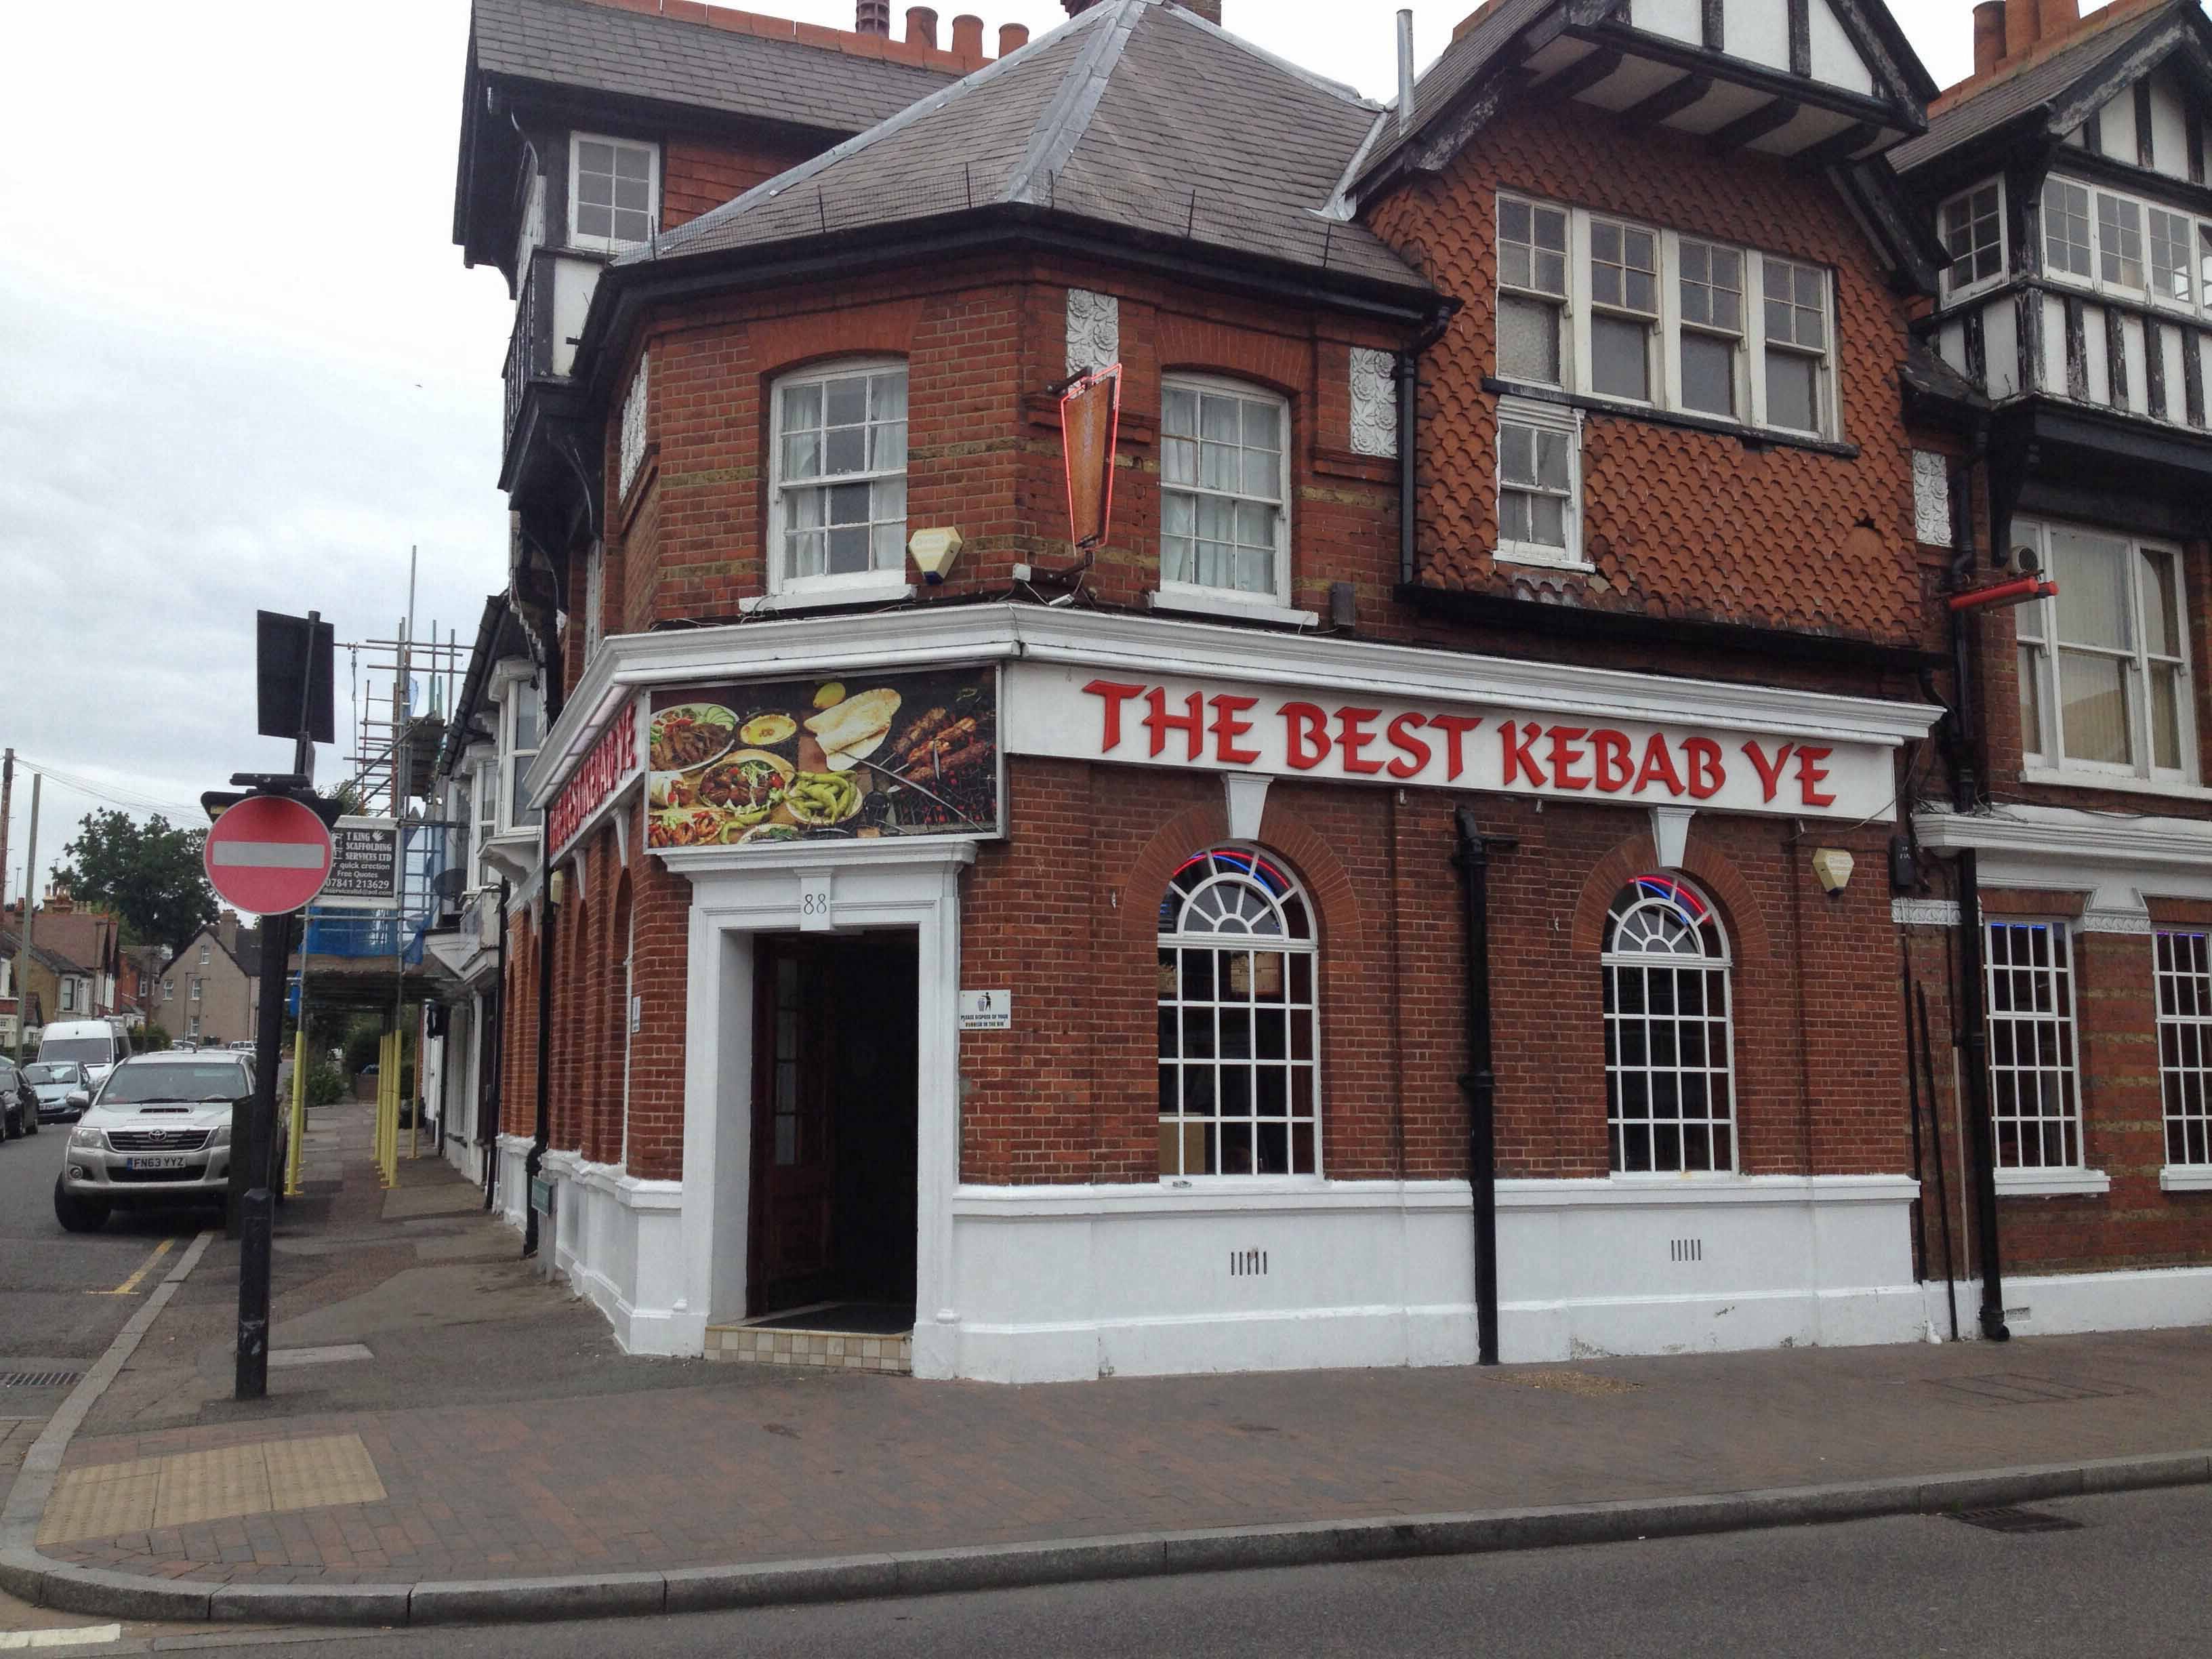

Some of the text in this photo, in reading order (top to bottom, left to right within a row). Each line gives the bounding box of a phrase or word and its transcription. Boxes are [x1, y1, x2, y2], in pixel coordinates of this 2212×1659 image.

[1082, 679, 1837, 807] THE BEST KEBAB YE
[353, 832, 370, 841] KING
[346, 842, 392, 852] SCAFFOLDING
[346, 851, 392, 862] SERVICES LTD
[354, 871, 378, 879] Quotes
[326, 878, 389, 889] 07841 213629
[804, 893, 827, 915] 88
[134, 1156, 184, 1168] FN63 YYZ
